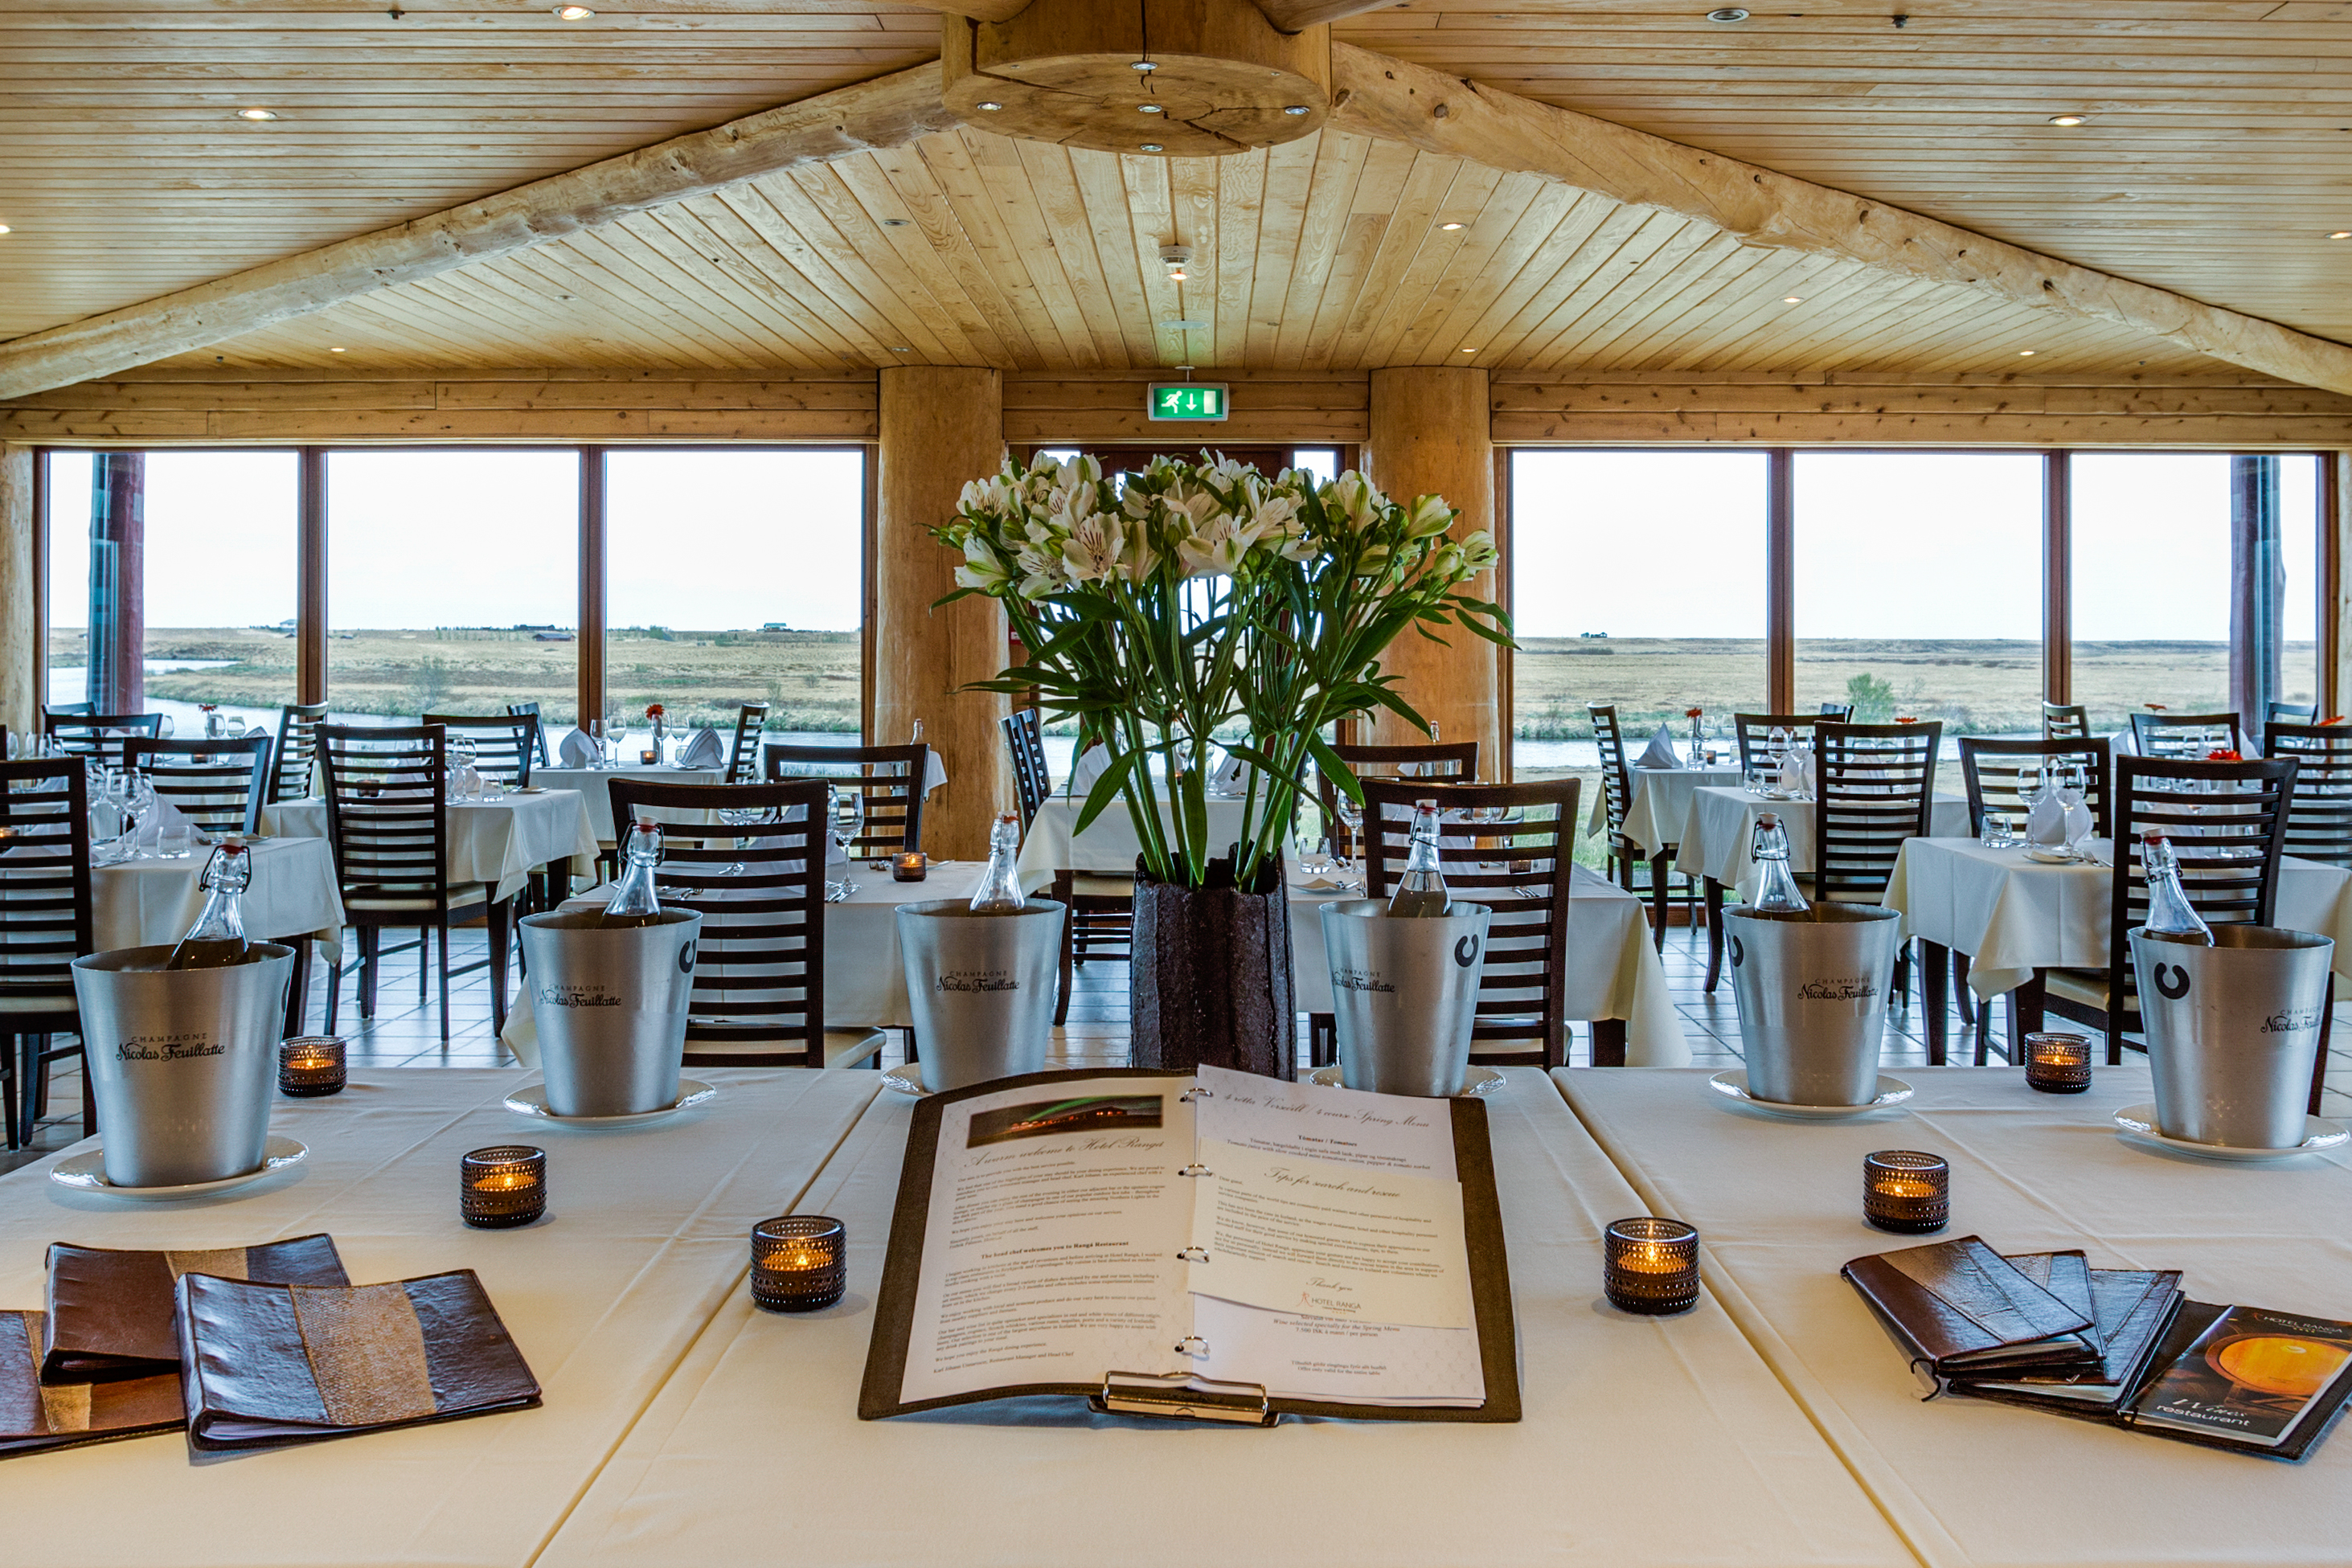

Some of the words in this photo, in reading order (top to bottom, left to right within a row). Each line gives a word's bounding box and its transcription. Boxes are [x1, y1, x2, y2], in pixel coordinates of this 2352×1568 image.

[936, 976, 971, 991] Nicolas
[972, 977, 1020, 993] Feuillatte
[1351, 976, 1395, 993] Feuillatte
[1797, 984, 1838, 1000] Nicolas
[539, 989, 569, 1006] Nicolas
[568, 992, 621, 1008] Feuillatte
[2260, 1015, 2299, 1034] Nicolas
[131, 1032, 207, 1042] CHAMPAGNE
[115, 1042, 160, 1061] Nicolas
[160, 1042, 225, 1062] Feuillatte
[1354, 1108, 1394, 1126] Spring
[1395, 1115, 1429, 1128] Menu
[984, 1155, 1015, 1165] warm
[1020, 1144, 1063, 1158] welcome
[1079, 1137, 1119, 1151] Hotel
[1264, 1166, 1293, 1183] Tips
[1290, 1174, 1309, 1186] for
[1312, 1181, 1348, 1191] search
[1346, 1186, 1375, 1194] and
[1372, 1189, 1400, 1197] rescue
[1023, 1245, 1052, 1253] welcomes
[1306, 1277, 1341, 1290] Thank
[1311, 1297, 1334, 1307] HOTEL
[1336, 1300, 1362, 1310] RANGA
[2264, 1316, 2297, 1326] HOTEL
[2157, 1405, 2251, 1427] restaurant
